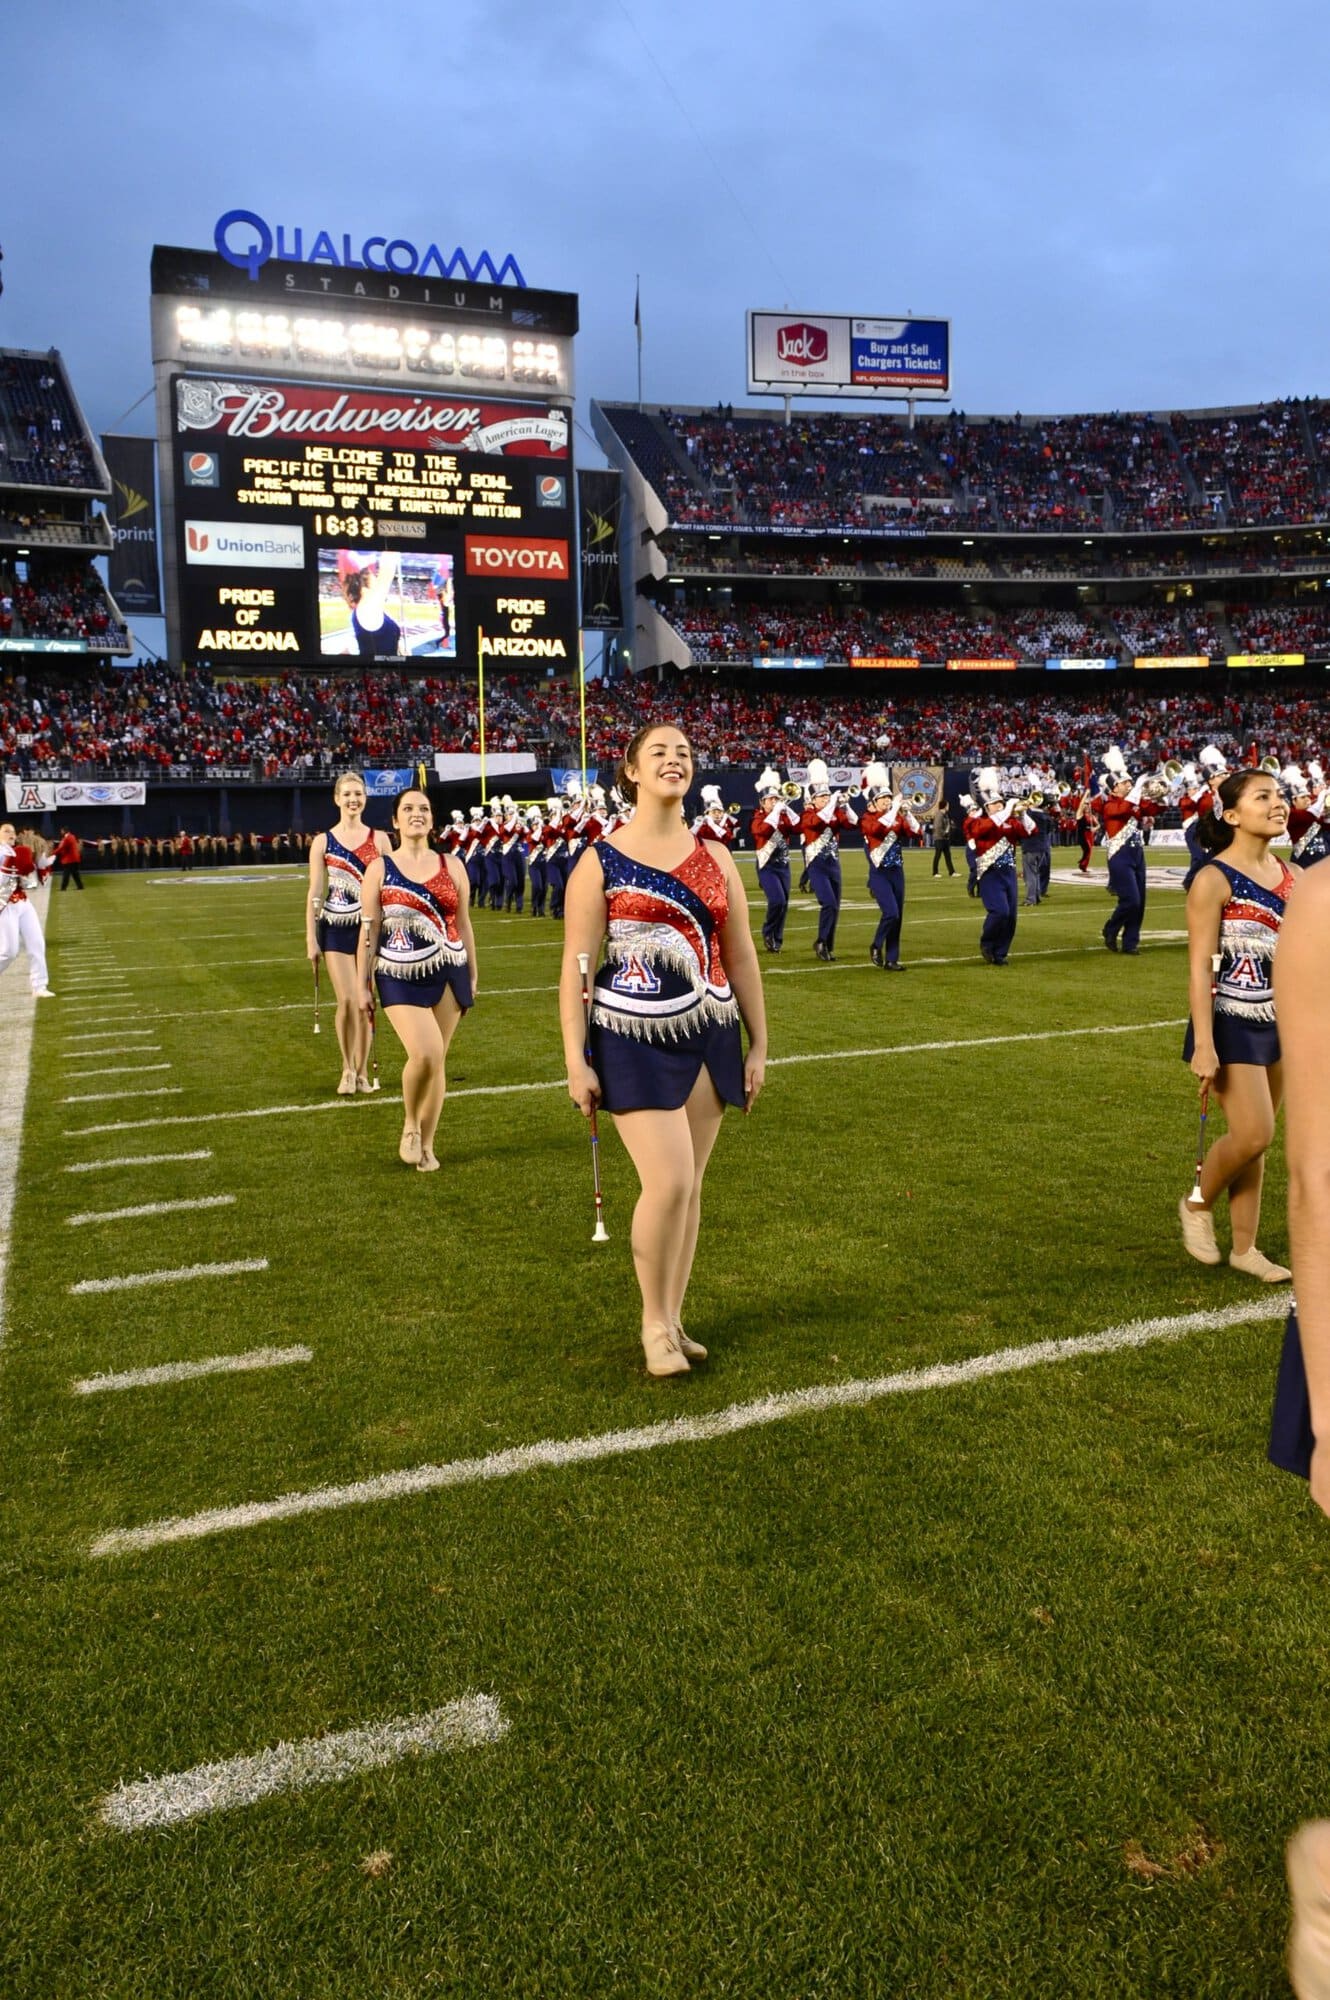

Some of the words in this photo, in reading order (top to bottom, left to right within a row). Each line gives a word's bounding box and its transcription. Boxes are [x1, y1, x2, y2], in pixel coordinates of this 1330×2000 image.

[214, 209, 526, 288] QUALCOMM
[285, 273, 503, 310] STADIUM
[779, 327, 826, 360] Jack
[870, 341, 888, 356] Buy
[890, 343, 909, 355] and
[911, 343, 929, 356] Sell
[858, 355, 902, 370] Chargers
[904, 357, 941, 370] Tickets!
[213, 391, 481, 438] Budweiser
[484, 425, 532, 446] American
[535, 424, 565, 439] Lager
[305, 446, 384, 466] WELCOME
[392, 452, 416, 467] TO
[424, 455, 457, 470] THE
[243, 458, 324, 478] PACIFIC
[333, 464, 378, 481] LIFE
[386, 468, 462, 486] HOLIDAY
[470, 473, 513, 490] BOWL
[254, 477, 326, 493] PRE-GAME
[332, 481, 368, 495] SHOW
[374, 484, 450, 500] PRESENTED
[456, 489, 474, 502] BY
[480, 490, 506, 504] THE
[237, 489, 293, 505] SYCUAN
[298, 492, 335, 508] BAND
[341, 495, 360, 509] OF
[367, 497, 394, 511] THE
[472, 503, 522, 518] NATION
[315, 514, 375, 538] 16:33
[216, 538, 302, 555] UnionBank
[470, 547, 565, 570] TOYOTA
[581, 551, 618, 566] Sprint
[219, 588, 275, 606] PRIDE
[496, 598, 546, 615] PRIDE
[235, 609, 260, 625] OF
[511, 618, 533, 633] OF
[198, 629, 300, 651] ARIZONA
[481, 637, 567, 657] ARIZONA
[852, 658, 885, 667] WELLS
[887, 658, 919, 668] FARGO
[19, 785, 45, 809] A
[387, 927, 414, 952] A
[612, 952, 661, 994] A
[1220, 951, 1268, 989] A
